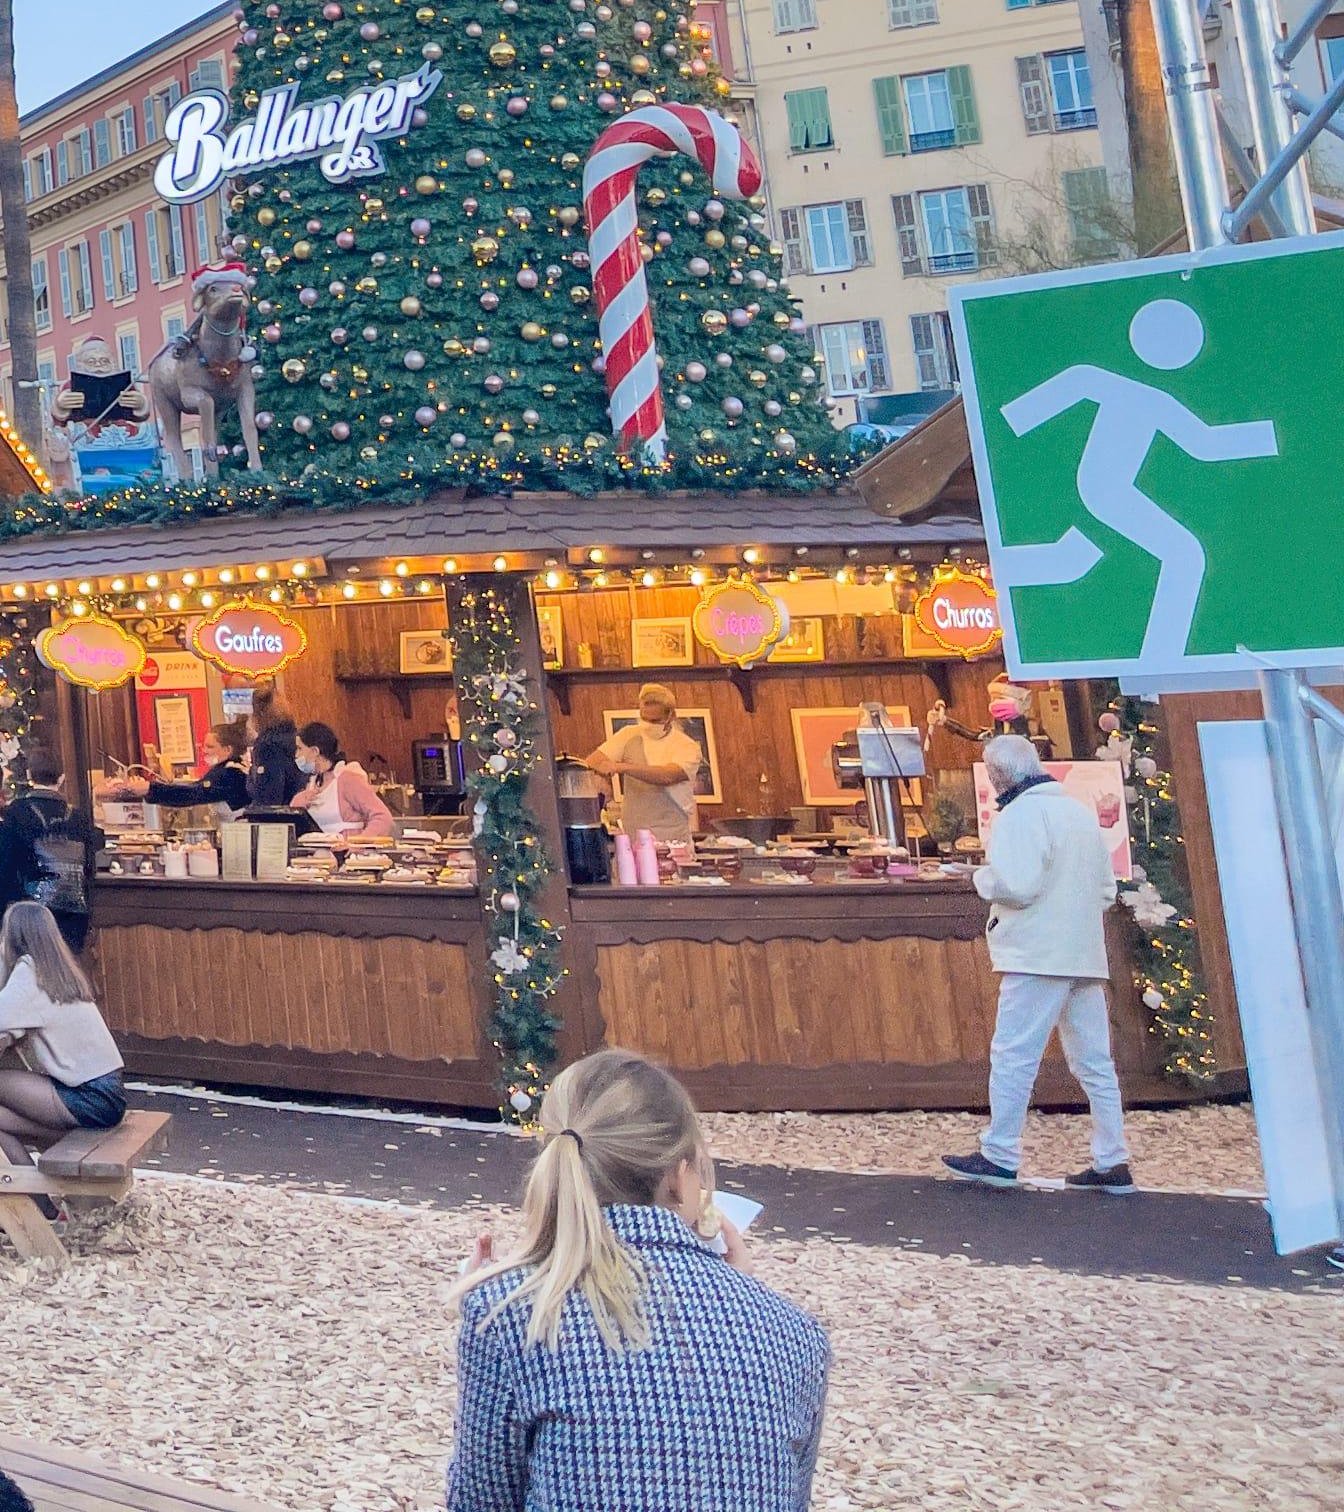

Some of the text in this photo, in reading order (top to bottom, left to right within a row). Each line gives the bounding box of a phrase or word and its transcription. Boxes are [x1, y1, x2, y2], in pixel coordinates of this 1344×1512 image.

[153, 68, 436, 194] Ballanger
[712, 608, 764, 645] Crêpes
[931, 596, 995, 630] Churros
[214, 624, 284, 654] Gaufres
